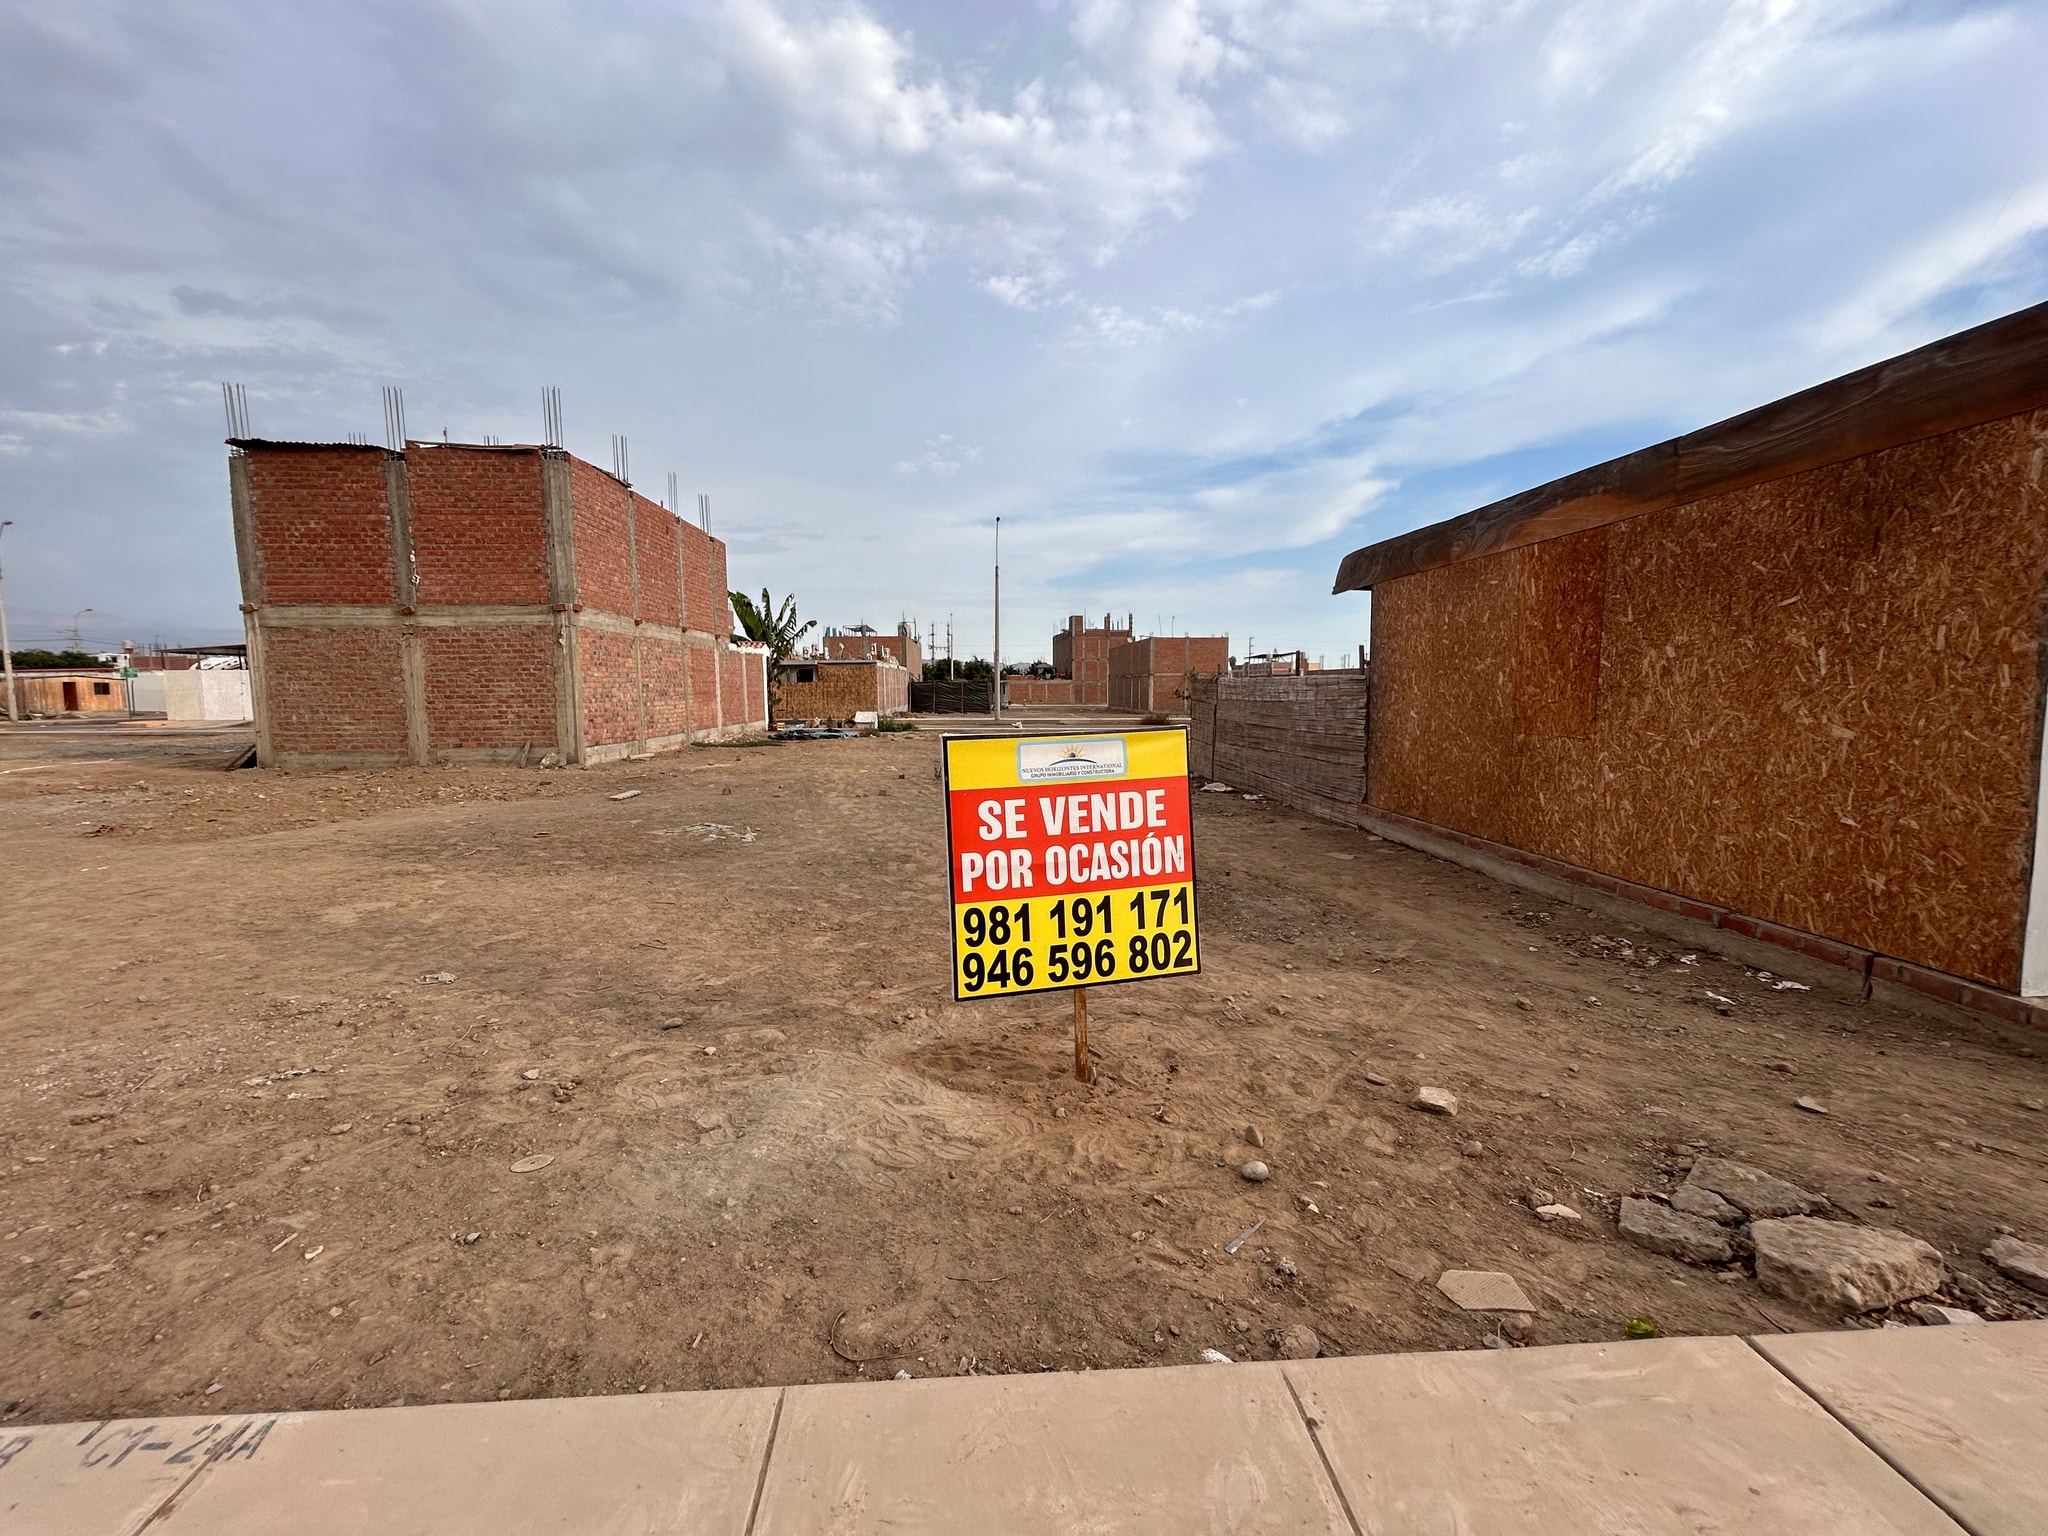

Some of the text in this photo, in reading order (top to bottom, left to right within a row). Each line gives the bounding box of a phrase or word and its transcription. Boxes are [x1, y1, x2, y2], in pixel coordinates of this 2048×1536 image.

[977, 789, 1167, 841] SE VENDE
[961, 831, 1185, 893] POR OCASIÓN
[963, 887, 1189, 947] 981 191 171
[962, 929, 1193, 992] 946 596 802
